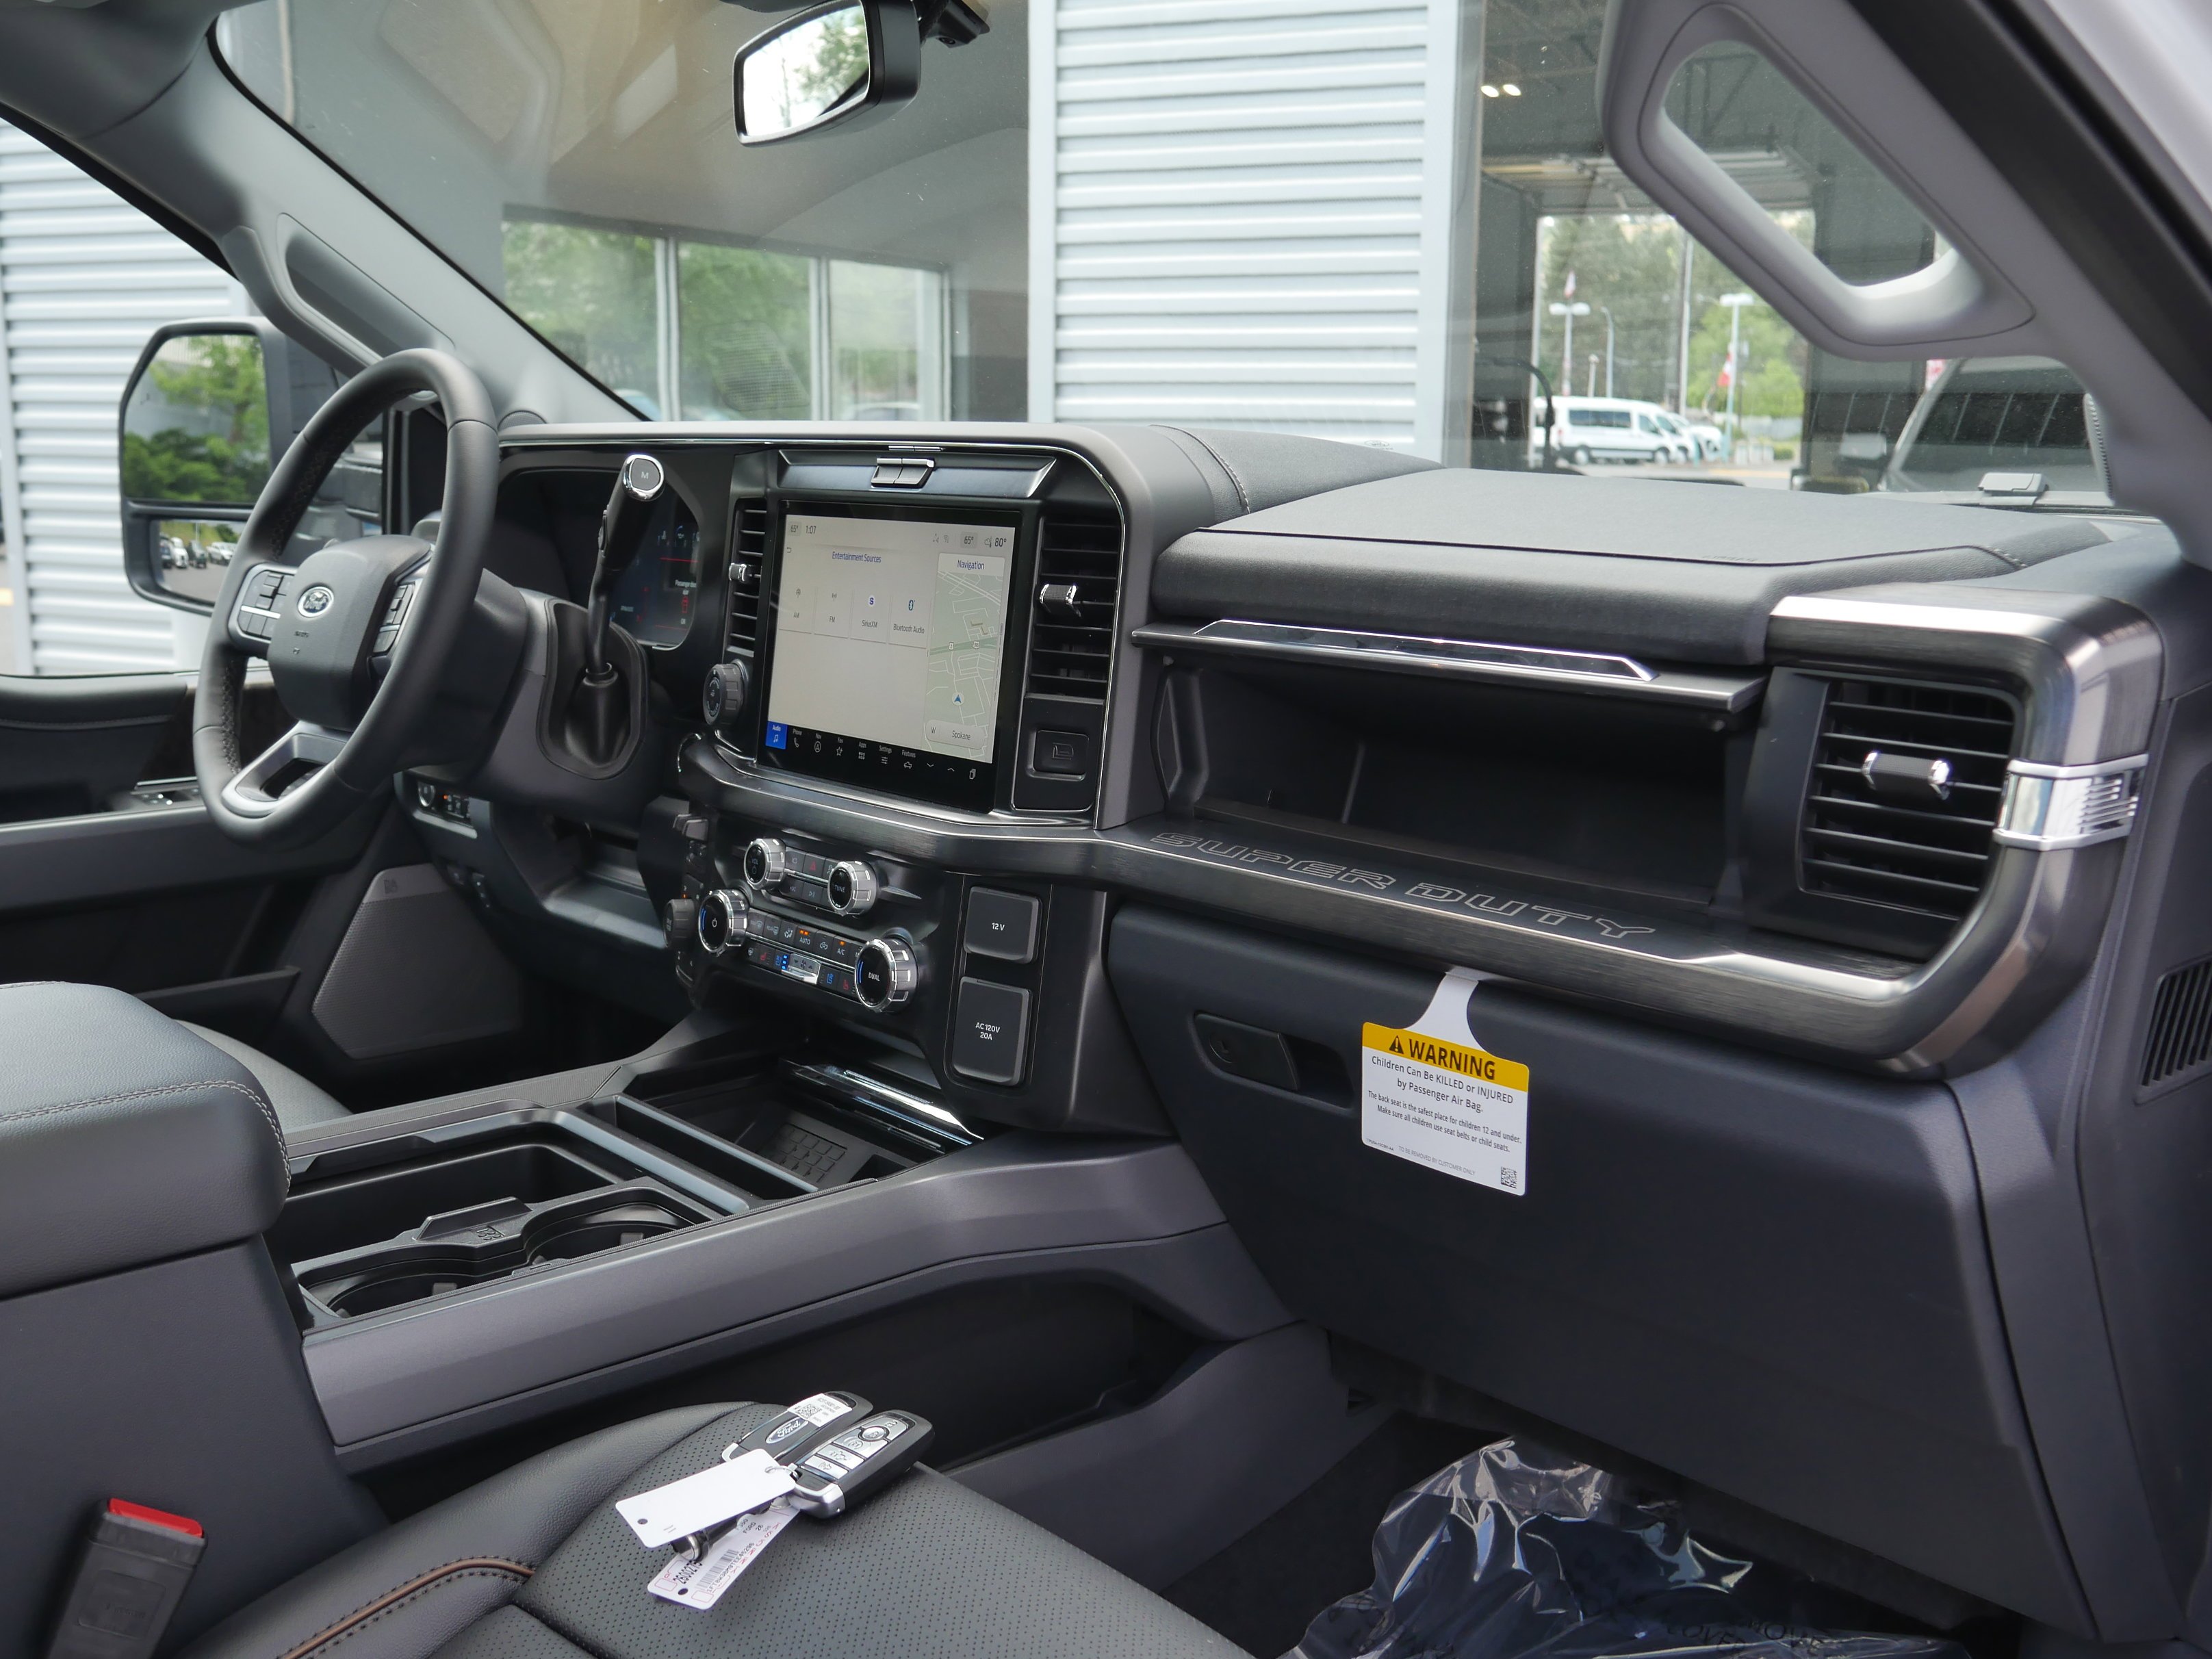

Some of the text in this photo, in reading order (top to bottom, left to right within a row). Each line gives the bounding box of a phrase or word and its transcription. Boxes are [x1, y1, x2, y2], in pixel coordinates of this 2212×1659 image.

[806, 526, 816, 534] 1:07
[832, 551, 882, 563] Entertainment Sources
[957, 560, 984, 570] Navigation
[862, 619, 877, 628] SiriusXM
[893, 623, 925, 634] Bluetooth Audio
[951, 730, 971, 741] Spokane
[879, 745, 892, 754] Settings
[902, 749, 916, 758] Features
[834, 884, 846, 892] TUNE
[1150, 832, 1656, 940] SUPER DUTY
[799, 937, 810, 945] AUTO
[868, 972, 880, 981] DUAL
[975, 1022, 1001, 1033] AC 120V
[980, 1032, 992, 1040] 20A
[1409, 1038, 1495, 1080] WARNING
[1372, 1055, 1404, 1073] Children
[1406, 1066, 1422, 1078] Can
[1424, 1070, 1434, 1081] Be
[1436, 1074, 1464, 1090] KILLED
[1477, 1086, 1513, 1104] INJURED
[1397, 1078, 1484, 1114] by Passenger Air Bag.
[1369, 1090, 1522, 1144] The back seat is the safest place for children 12 and under.
[1377, 1105, 1391, 1116] Make
[1392, 1110, 1403, 1120] sure
[1412, 1116, 1432, 1129] children
[1433, 1124, 1443, 1133] use
[1444, 1127, 1455, 1136] seat
[1456, 1129, 1470, 1141] belts
[1478, 1137, 1492, 1147] child
[1493, 1142, 1510, 1153] seats.
[1411, 1148, 1431, 1162] REMOVED
[1438, 1159, 1462, 1172] CUSTOMER
[1463, 1166, 1476, 1176] ONLY
[777, 1420, 801, 1438] Ford
[743, 1521, 756, 1534] FORD
